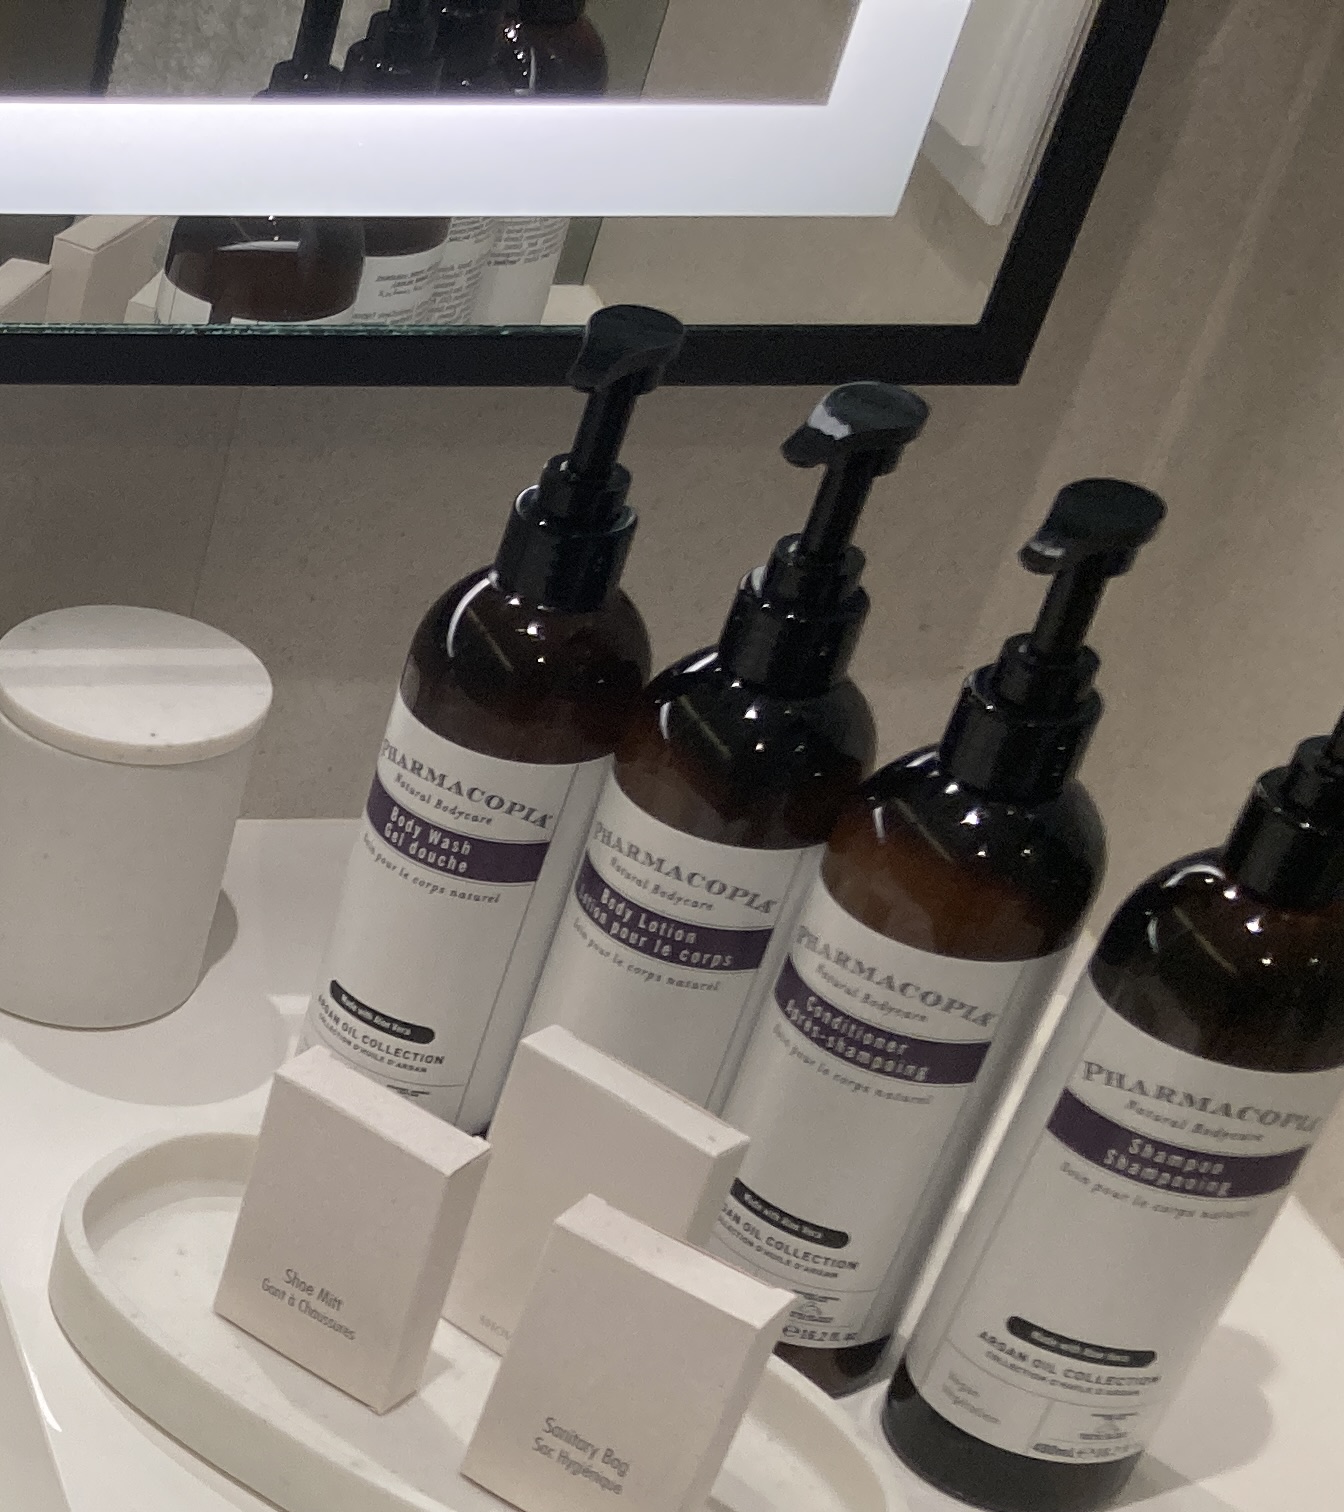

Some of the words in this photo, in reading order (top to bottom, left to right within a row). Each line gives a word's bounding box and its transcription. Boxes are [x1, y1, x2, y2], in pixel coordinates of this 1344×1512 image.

[381, 738, 549, 829] PHARMACOPIA
[390, 805, 422, 838] Body
[428, 828, 472, 855] Wash
[434, 798, 493, 825] Bodycare
[384, 822, 404, 847] Gel
[408, 841, 468, 873] douche
[594, 821, 777, 914] PHARMACOPIA
[412, 874, 445, 895] corps
[600, 887, 633, 922] Body
[638, 912, 697, 944] Lotion
[610, 920, 648, 947] pour
[654, 939, 672, 957] le
[679, 949, 734, 969] corps
[341, 1021, 358, 1039] OIL
[362, 1034, 445, 1065] COLLECTION
[1129, 1138, 1224, 1175] Shampoo
[743, 1222, 762, 1241] OIL
[766, 1237, 859, 1270] COLLECTION
[262, 1278, 286, 1300] Gant
[284, 1268, 314, 1296] Shoe
[317, 1288, 343, 1311] Mitt
[532, 1437, 554, 1459] Sac
[542, 1417, 600, 1460] Sanitary
[602, 1448, 629, 1477] Bag
